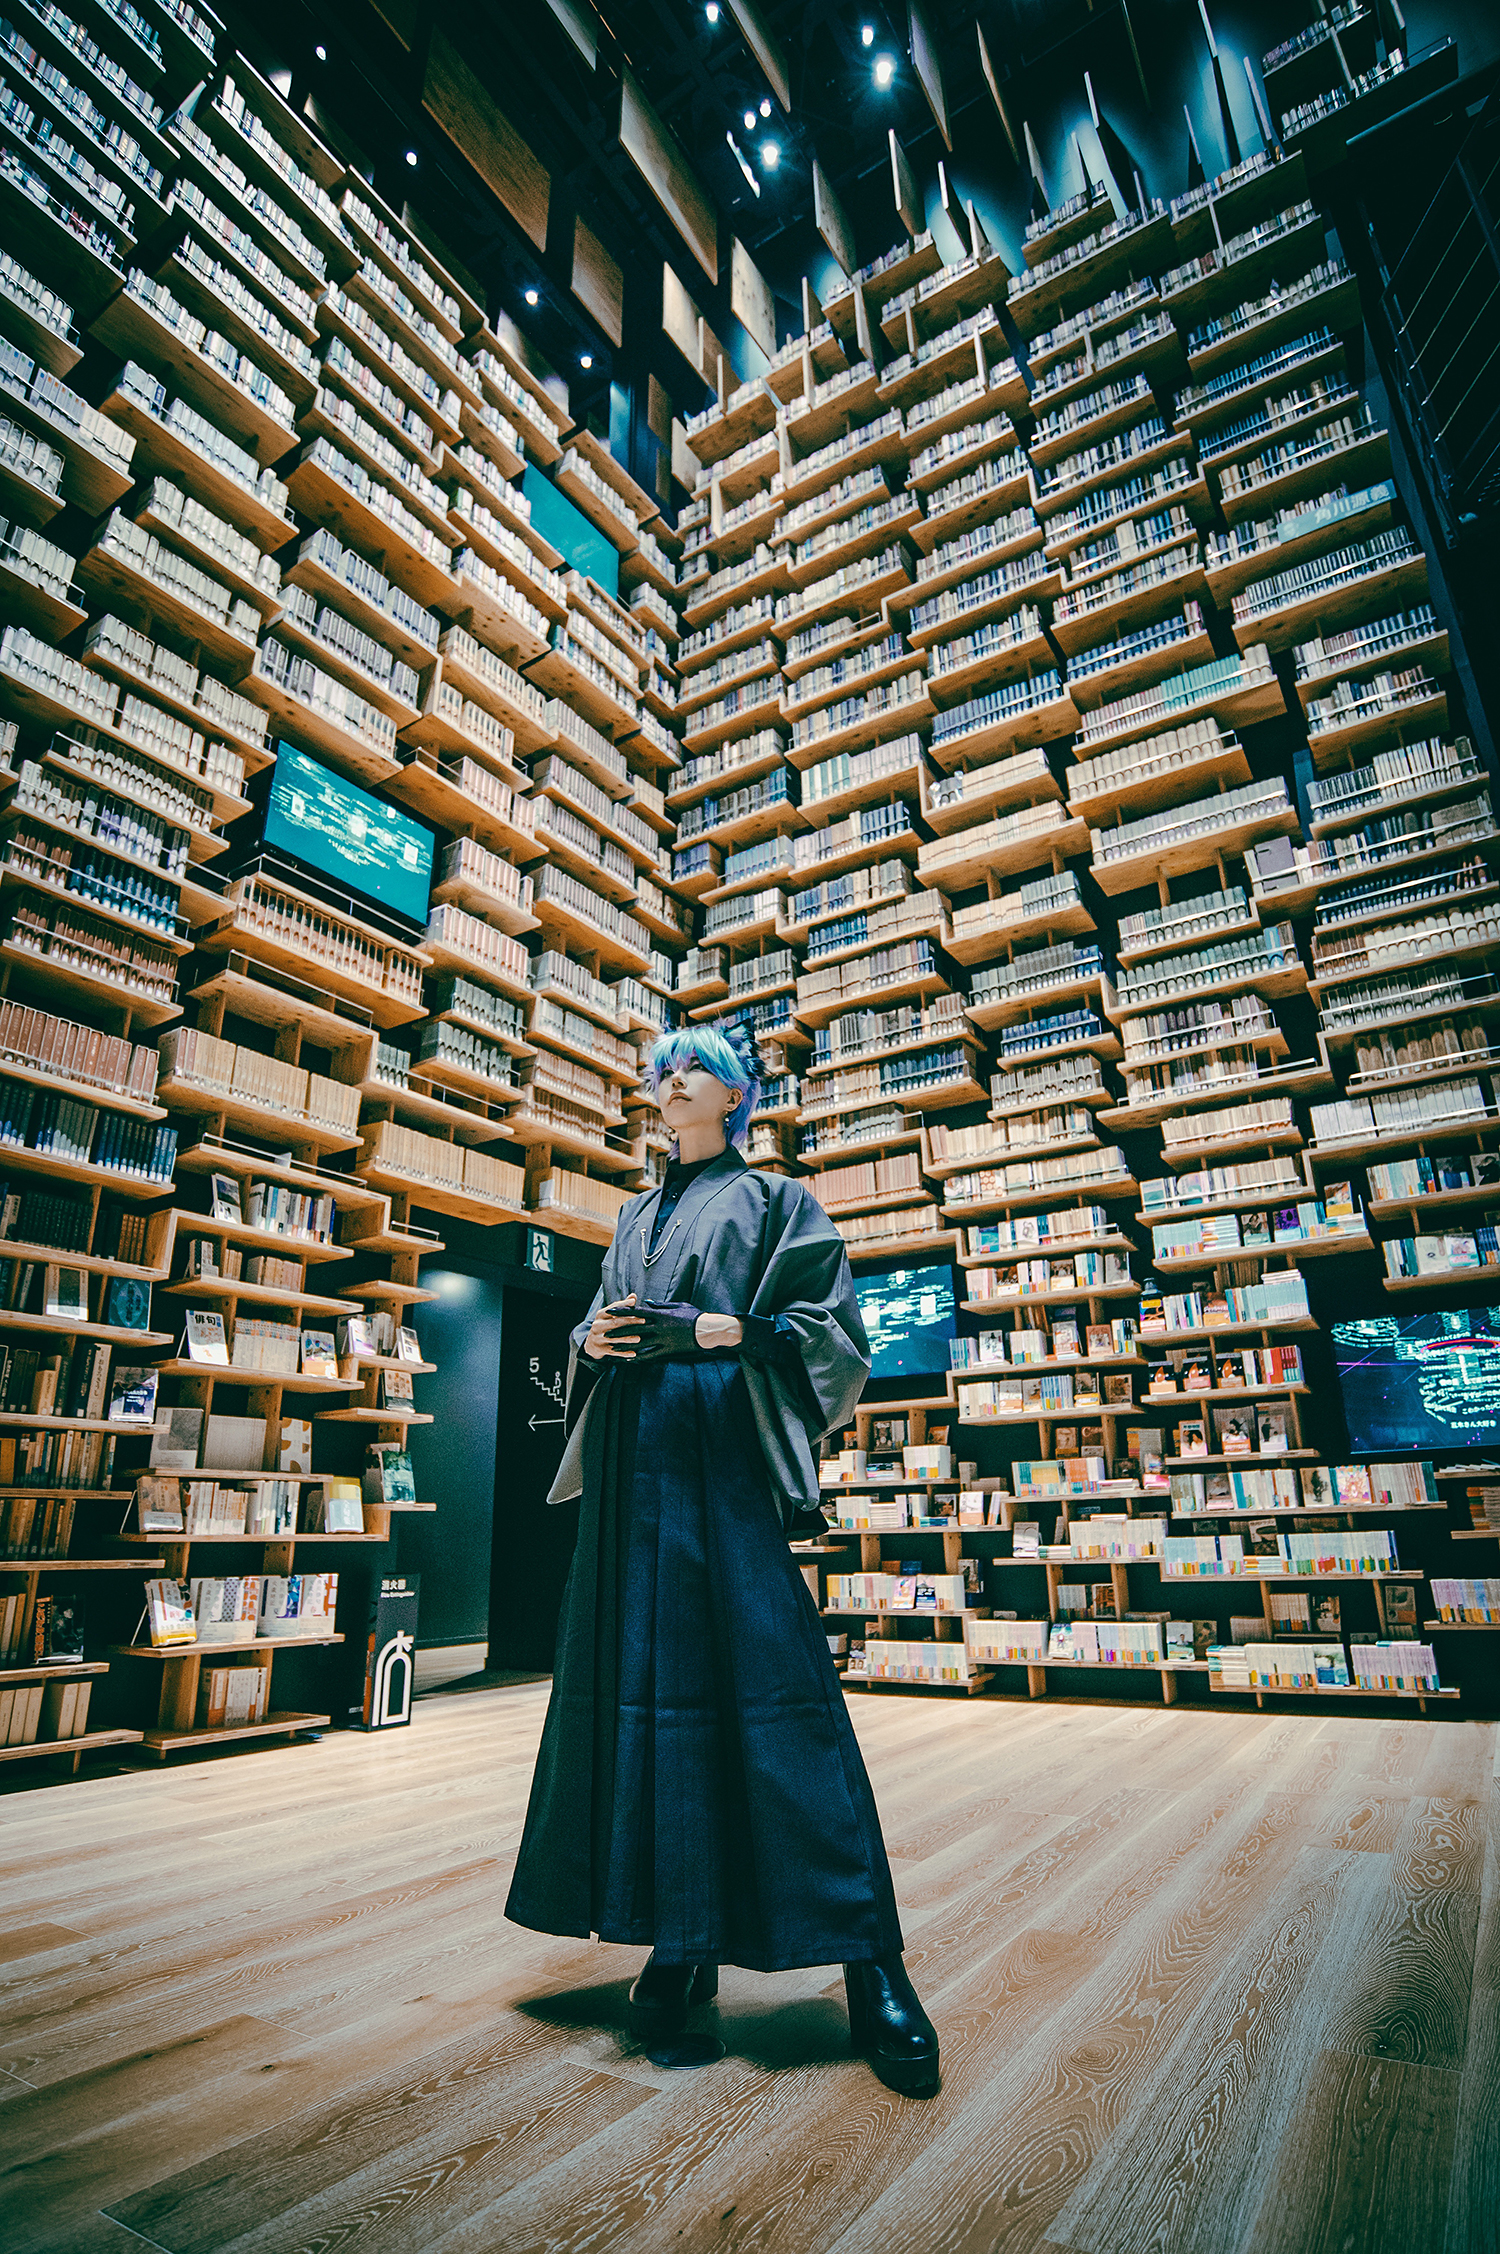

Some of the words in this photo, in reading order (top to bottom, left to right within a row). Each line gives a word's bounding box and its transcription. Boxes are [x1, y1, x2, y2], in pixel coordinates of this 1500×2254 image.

[194, 1314, 216, 1326] 俳句
[529, 1357, 539, 1373] 5
[381, 1579, 406, 1591] 消火器
